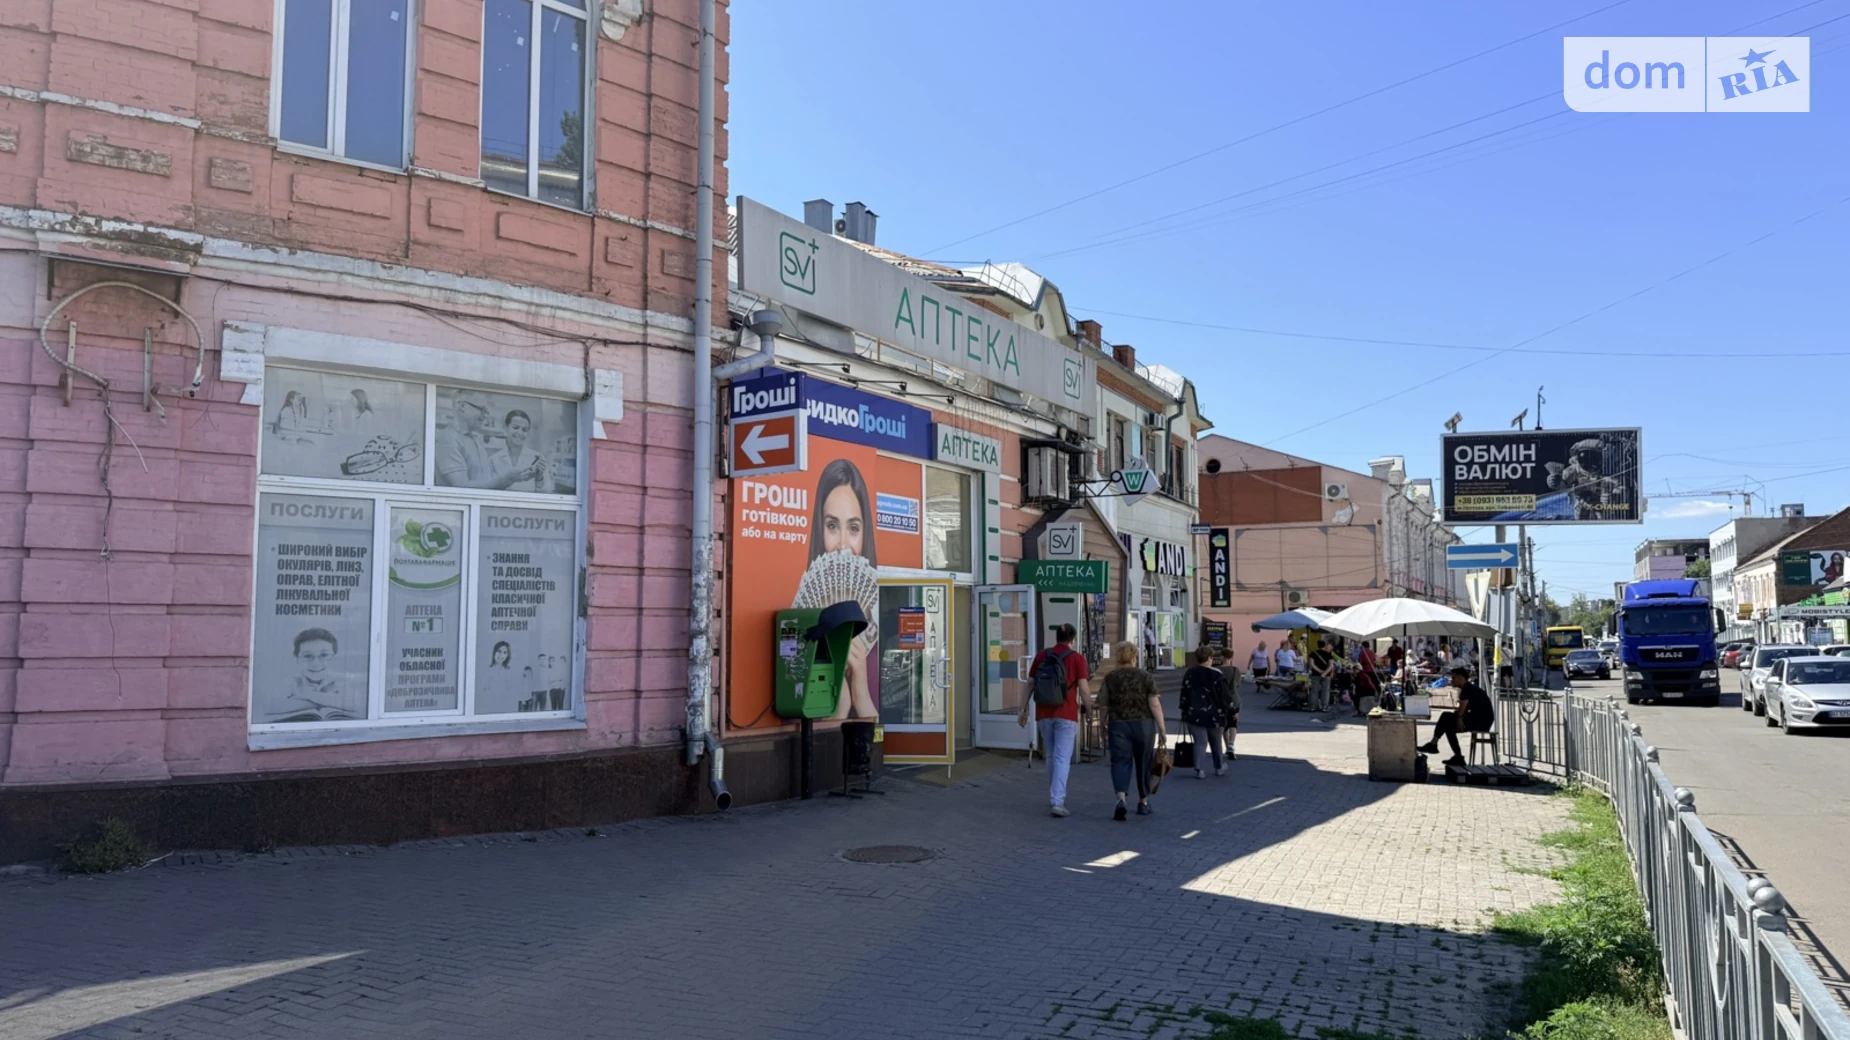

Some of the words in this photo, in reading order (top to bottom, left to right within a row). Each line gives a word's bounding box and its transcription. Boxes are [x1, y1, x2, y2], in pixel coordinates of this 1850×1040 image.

[895, 286, 1020, 377] АПТЕКА
[734, 377, 796, 414] Гроші
[807, 399, 906, 439] видкоГроші
[941, 433, 998, 466] АПТЕКА
[1454, 443, 1536, 463] ОБМІН
[1455, 463, 1536, 480] ВАЛЮТ
[742, 480, 808, 510] ГРОШІ
[270, 502, 364, 520] ПОСЛУГИ
[742, 507, 808, 528] готівкою
[487, 515, 565, 530] ПОСЛУГИ
[741, 525, 761, 538] або
[763, 530, 776, 540] на
[779, 531, 807, 544] карту
[278, 543, 333, 556] ШИРОКИЙ
[335, 546, 367, 558] ВИБІР
[492, 552, 530, 564] ЗНАННЯ
[277, 558, 334, 572] ОКУЛЯРІВ,
[336, 561, 364, 573] ЛІНЗ,
[492, 566, 504, 577] ТА
[505, 567, 543, 579] ДОСВІД
[1036, 565, 1095, 577] АПТЕКА
[277, 573, 316, 587] ОПРАВ,
[318, 574, 360, 587] ЕЛІТНОЇ
[1215, 549, 1226, 599] ANDI
[492, 579, 556, 592] СПЕЦІАЛІСТІВ
[276, 588, 350, 601] ЛІКУВАЛЬНОЇ
[491, 592, 546, 604] КЛАСИЧНОЇ
[275, 603, 342, 616] КОСМЕТИКИ
[405, 604, 443, 616] АПТЕКА
[491, 605, 537, 618] АПТЕЧНОЇ
[491, 620, 528, 632] СПРАВИ
[402, 647, 444, 658] УЧАСНИК
[399, 659, 446, 672] ОБЛАСНОЇ
[398, 674, 446, 685] ПРОГРАМИ
